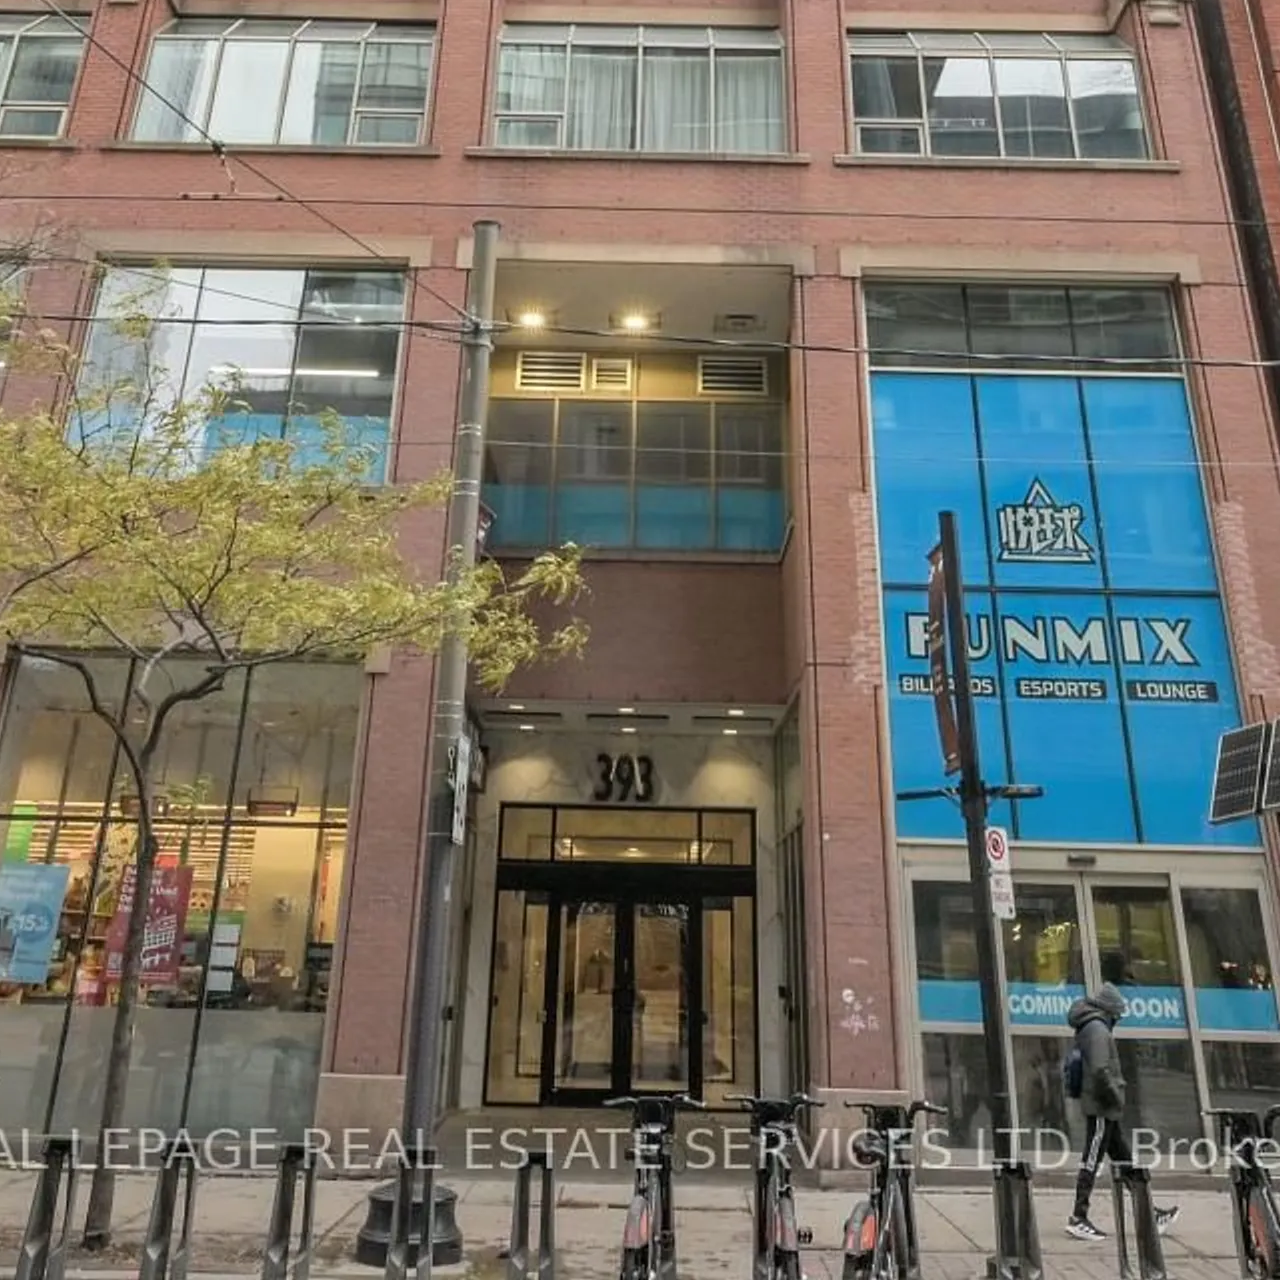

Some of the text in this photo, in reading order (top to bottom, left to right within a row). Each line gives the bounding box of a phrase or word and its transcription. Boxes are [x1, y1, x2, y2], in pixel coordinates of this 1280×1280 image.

[901, 675, 1209, 700] BILLDS ESPORTS LOUNGE
[594, 752, 654, 803] 393
[1008, 993, 1084, 1017] COMIN
